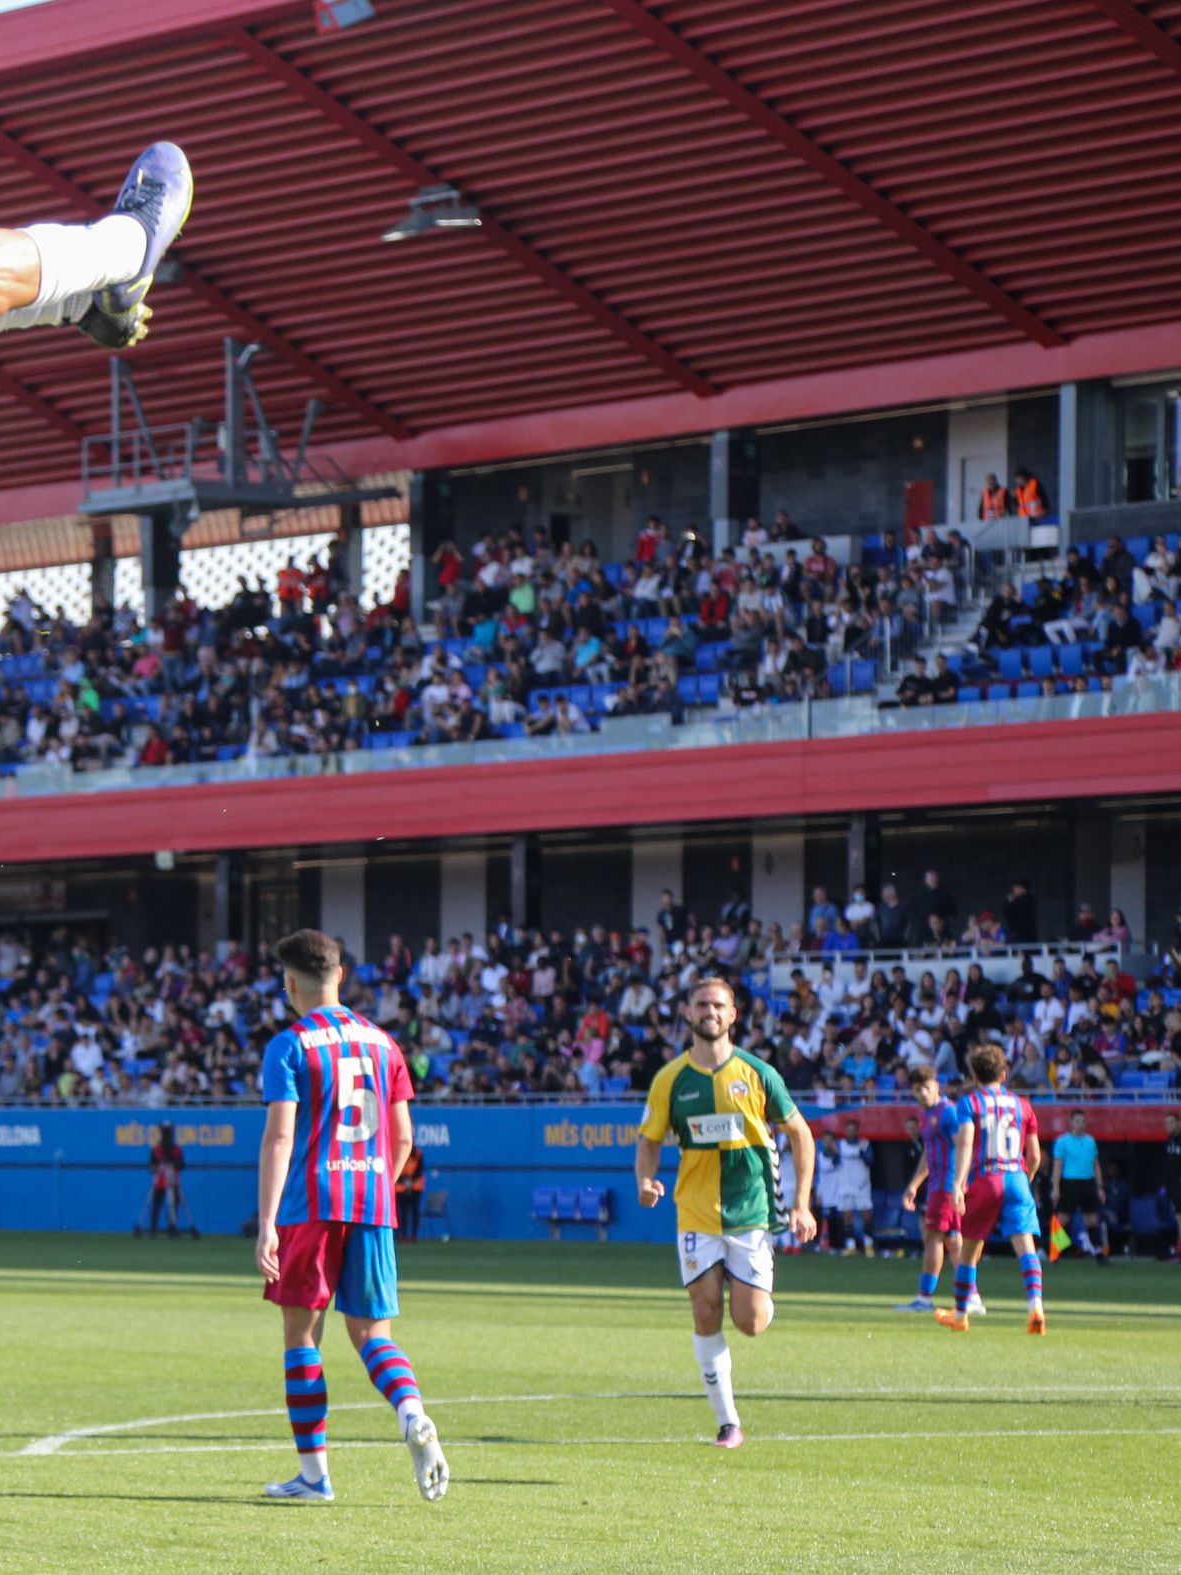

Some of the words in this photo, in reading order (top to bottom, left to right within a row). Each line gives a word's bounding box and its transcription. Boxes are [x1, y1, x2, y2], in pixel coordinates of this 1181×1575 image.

[336, 1056, 379, 1143] 5
[544, 1118, 579, 1147] MÉS
[582, 1123, 614, 1150] QUE
[980, 1112, 1020, 1159] 16
[326, 1156, 374, 1172] unicef
